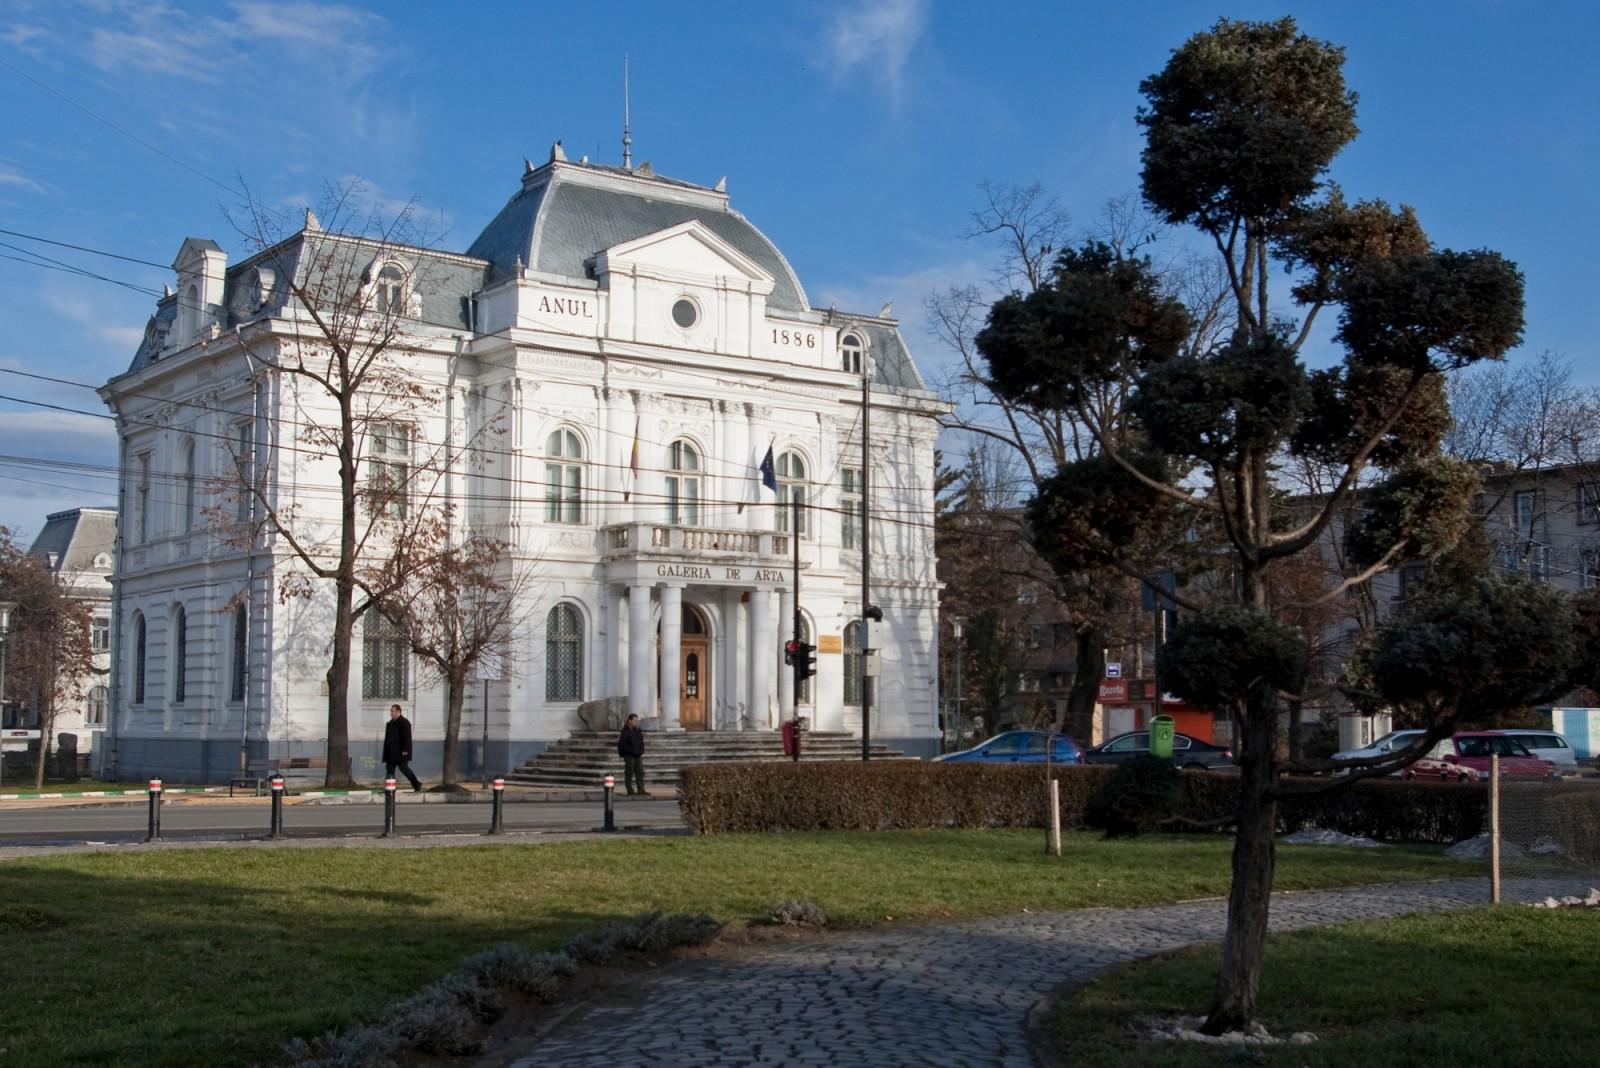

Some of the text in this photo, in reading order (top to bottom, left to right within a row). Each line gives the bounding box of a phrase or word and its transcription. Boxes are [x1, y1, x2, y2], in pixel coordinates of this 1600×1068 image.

[538, 295, 593, 318] ANUL
[772, 328, 816, 349] 1886
[657, 564, 785, 582] GALERIA DE ARTA
